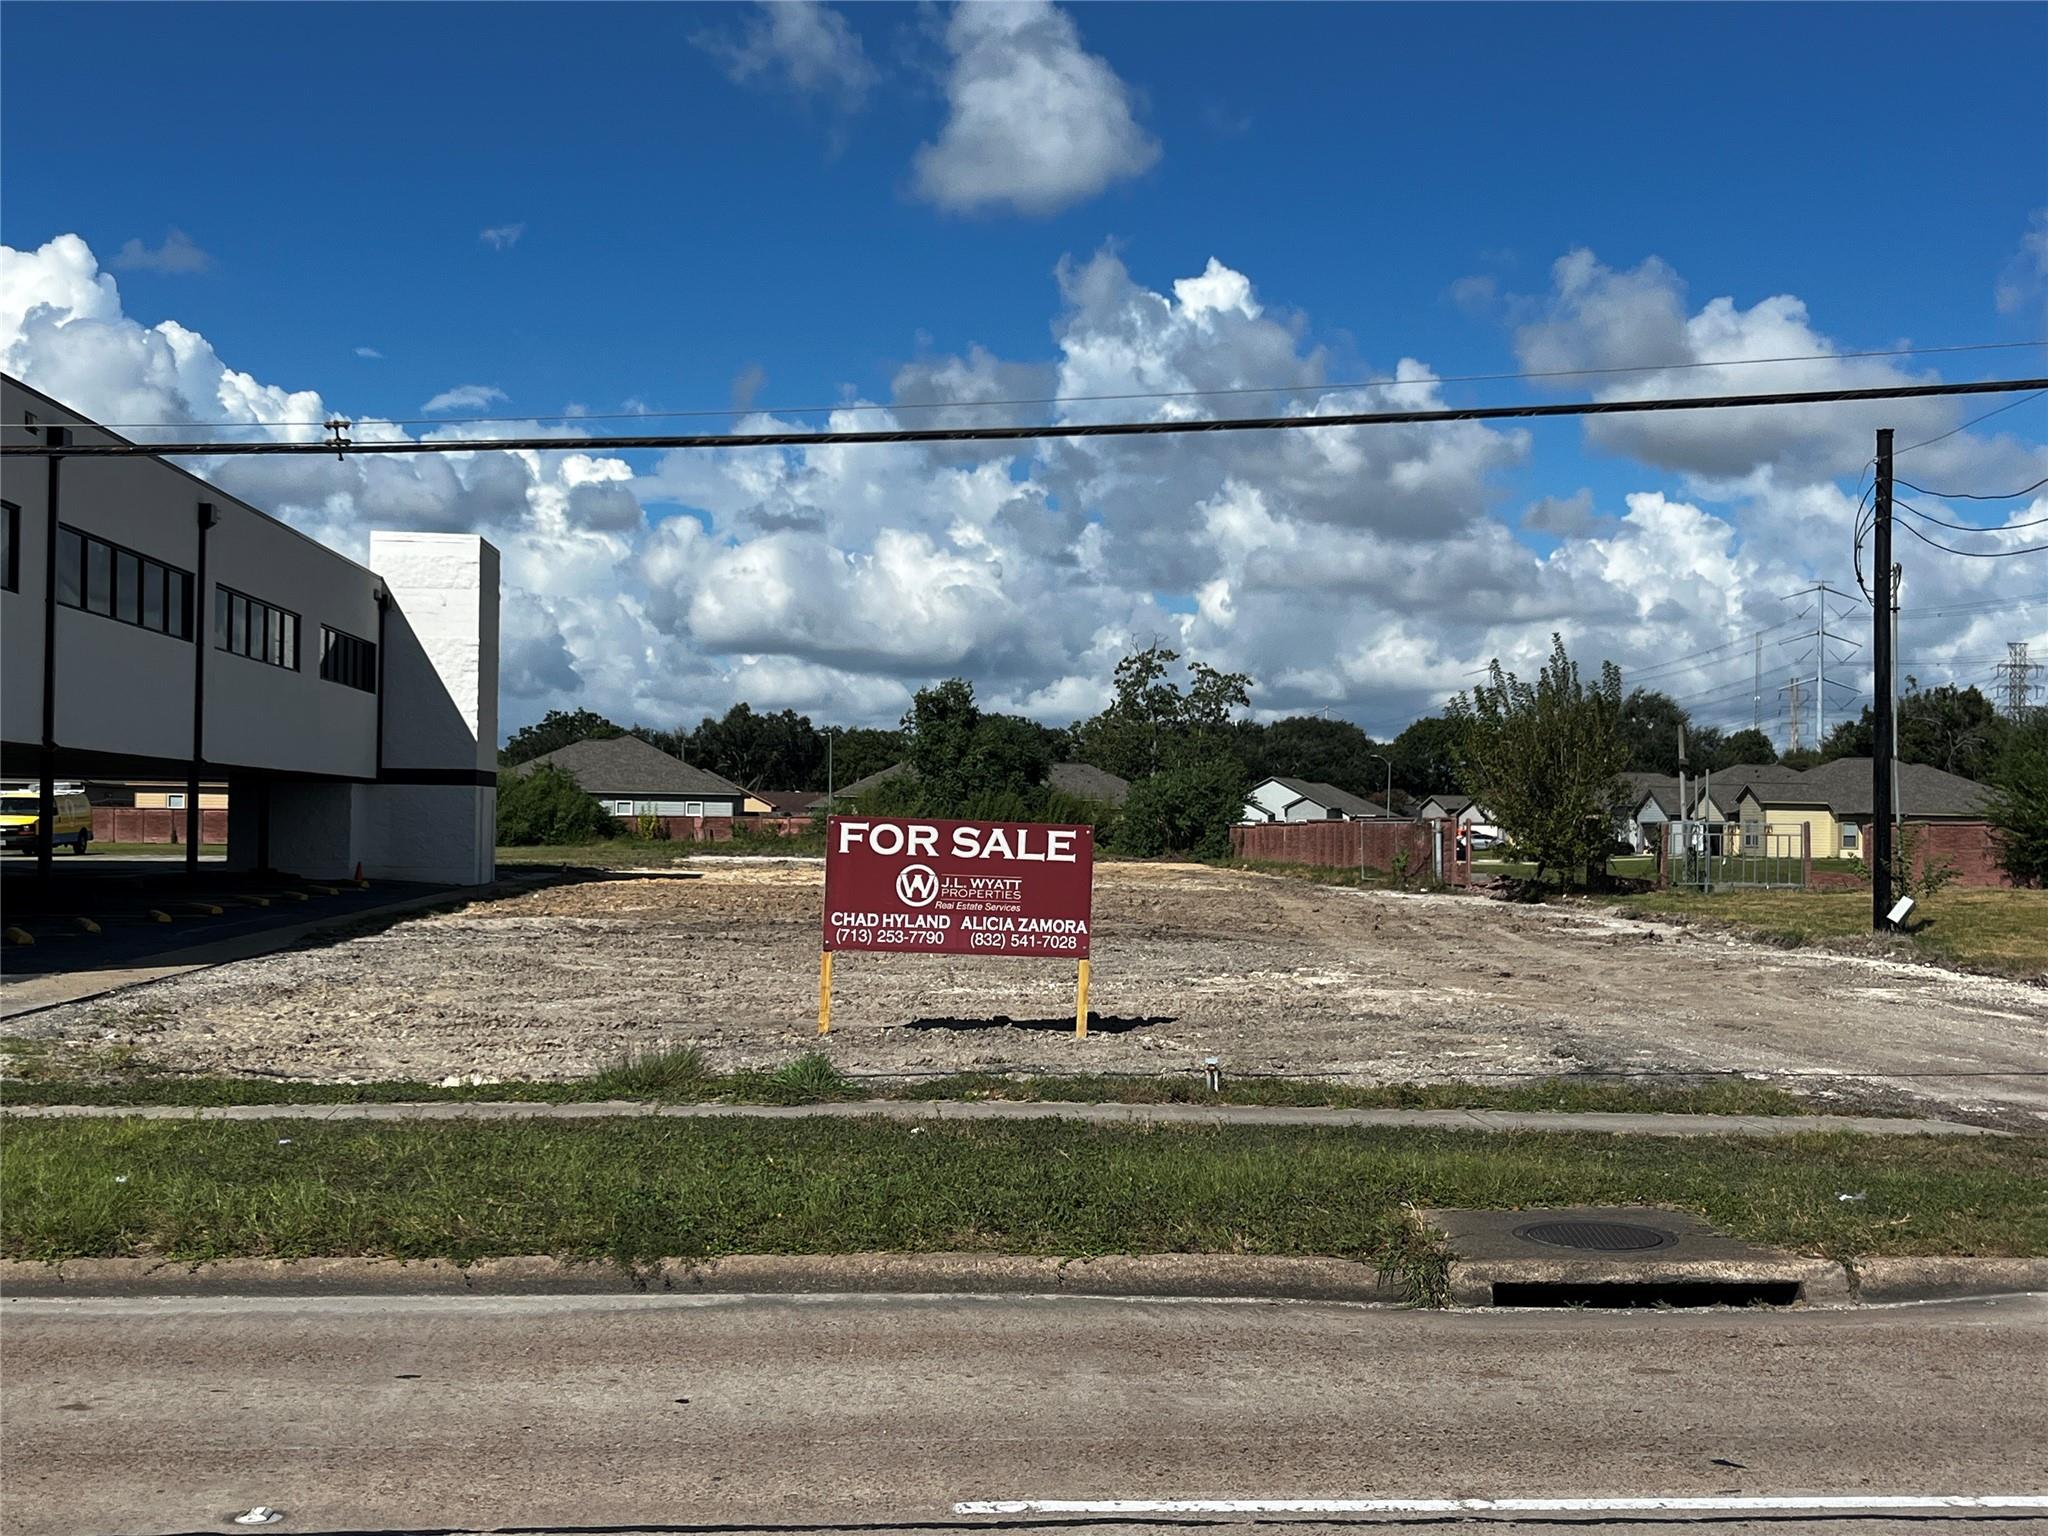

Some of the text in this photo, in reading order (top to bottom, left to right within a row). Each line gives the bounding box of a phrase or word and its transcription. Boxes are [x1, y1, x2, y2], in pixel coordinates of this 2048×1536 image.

[838, 822, 1077, 863] FOR SALE
[941, 877, 1023, 891] J.L. WYATT
[941, 888, 1022, 900] PROPERTIES
[935, 901, 1021, 913] Real Estate Services
[831, 912, 951, 930] CHAD HYLAND
[960, 916, 1088, 935] ALICIA ZAMORA
[836, 929, 945, 946] (713) 253-7790
[970, 932, 1077, 950] (832) 541-7028
